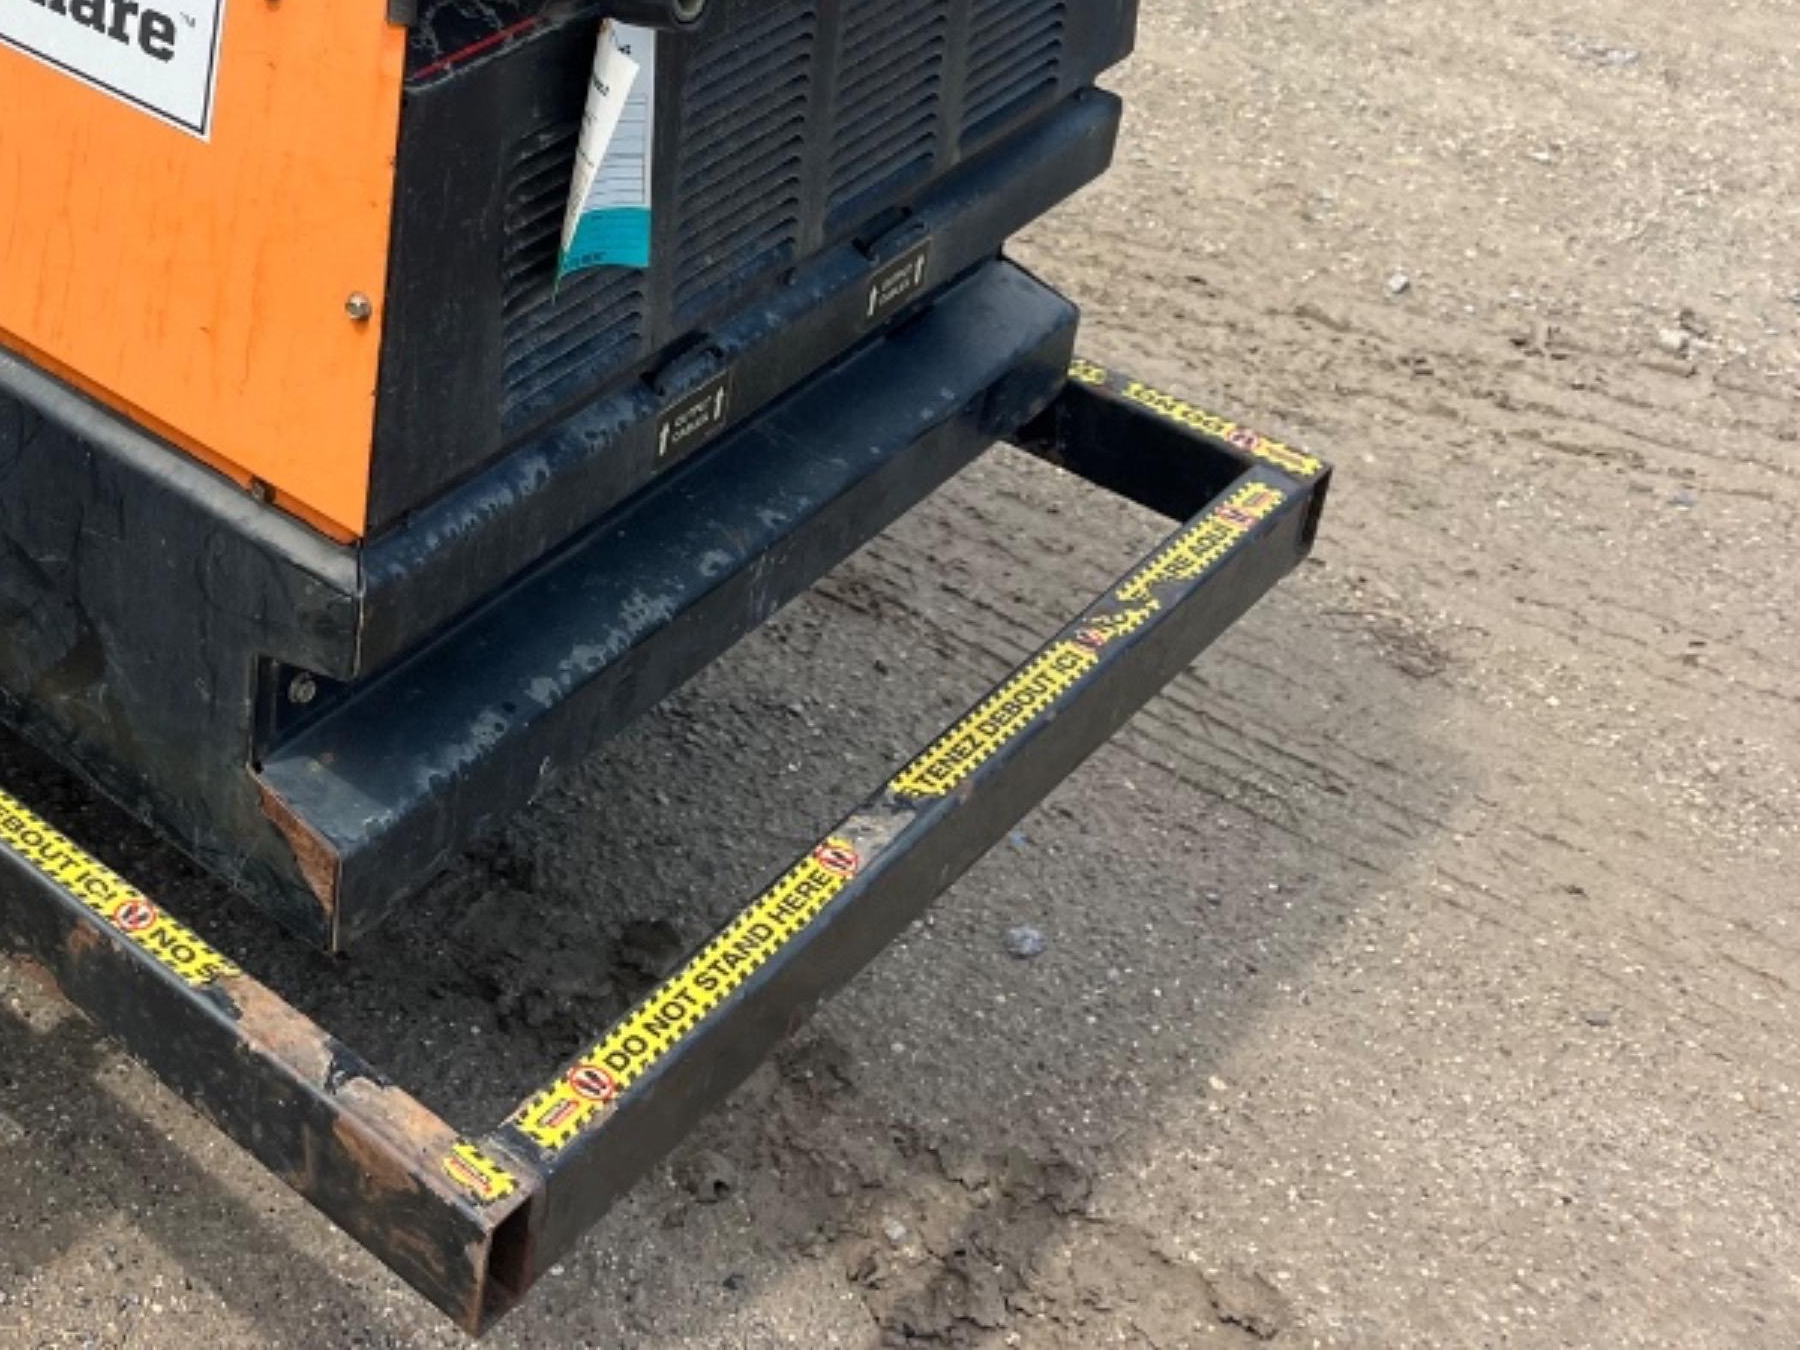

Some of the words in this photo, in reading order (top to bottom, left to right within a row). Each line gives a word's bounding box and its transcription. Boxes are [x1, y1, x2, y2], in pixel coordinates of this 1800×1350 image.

[913, 733, 985, 787] TENEZ
[976, 671, 1057, 737] DEBOUT
[74, 871, 119, 902] ICI
[150, 925, 197, 965] NO
[603, 1034, 649, 1073] DO
[641, 986, 699, 1039] NOT
[692, 921, 775, 993] STAND
[766, 868, 833, 926] HERE
